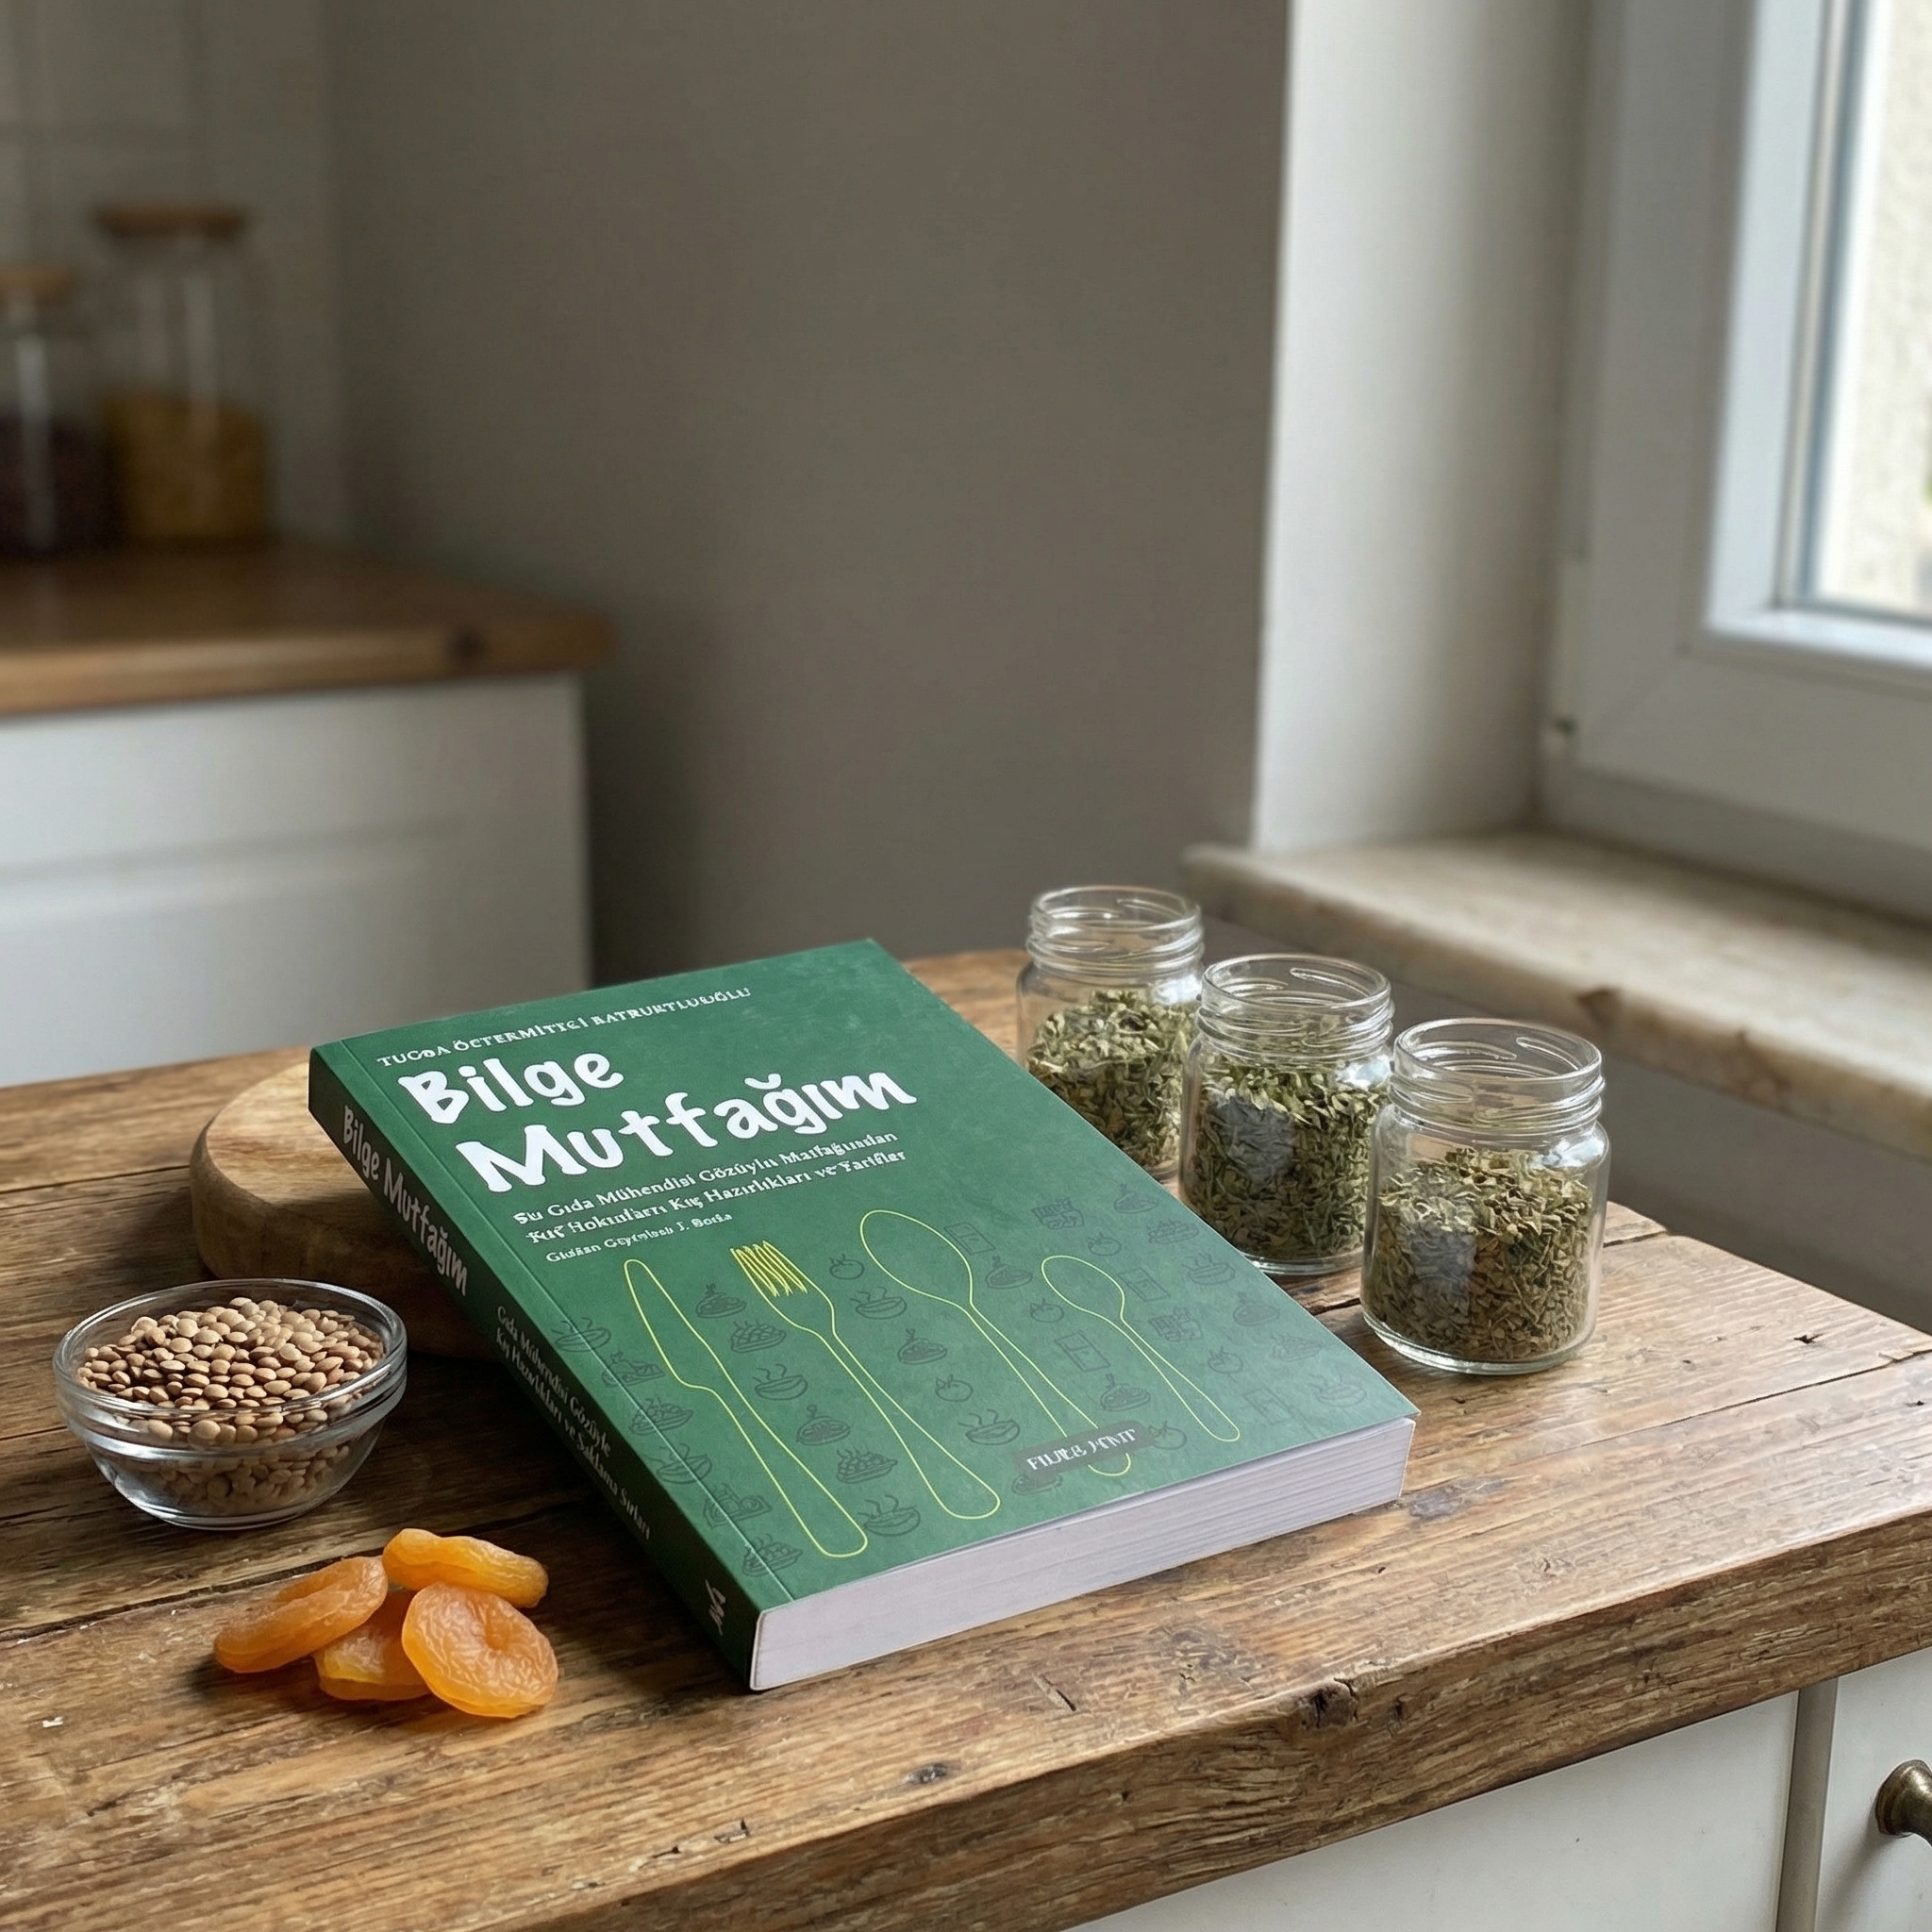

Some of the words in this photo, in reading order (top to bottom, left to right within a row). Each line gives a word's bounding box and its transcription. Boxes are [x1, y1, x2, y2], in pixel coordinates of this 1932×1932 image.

[398, 1052, 624, 1124] Bilge
[342, 1105, 380, 1180] Bilge
[456, 1072, 918, 1193] Mutfağım
[547, 1198, 595, 1217] Gıda
[596, 1174, 696, 1206] Mühendisi
[706, 1171, 812, 1203] Hazırlıkları
[383, 1157, 469, 1297] Mutfağım
